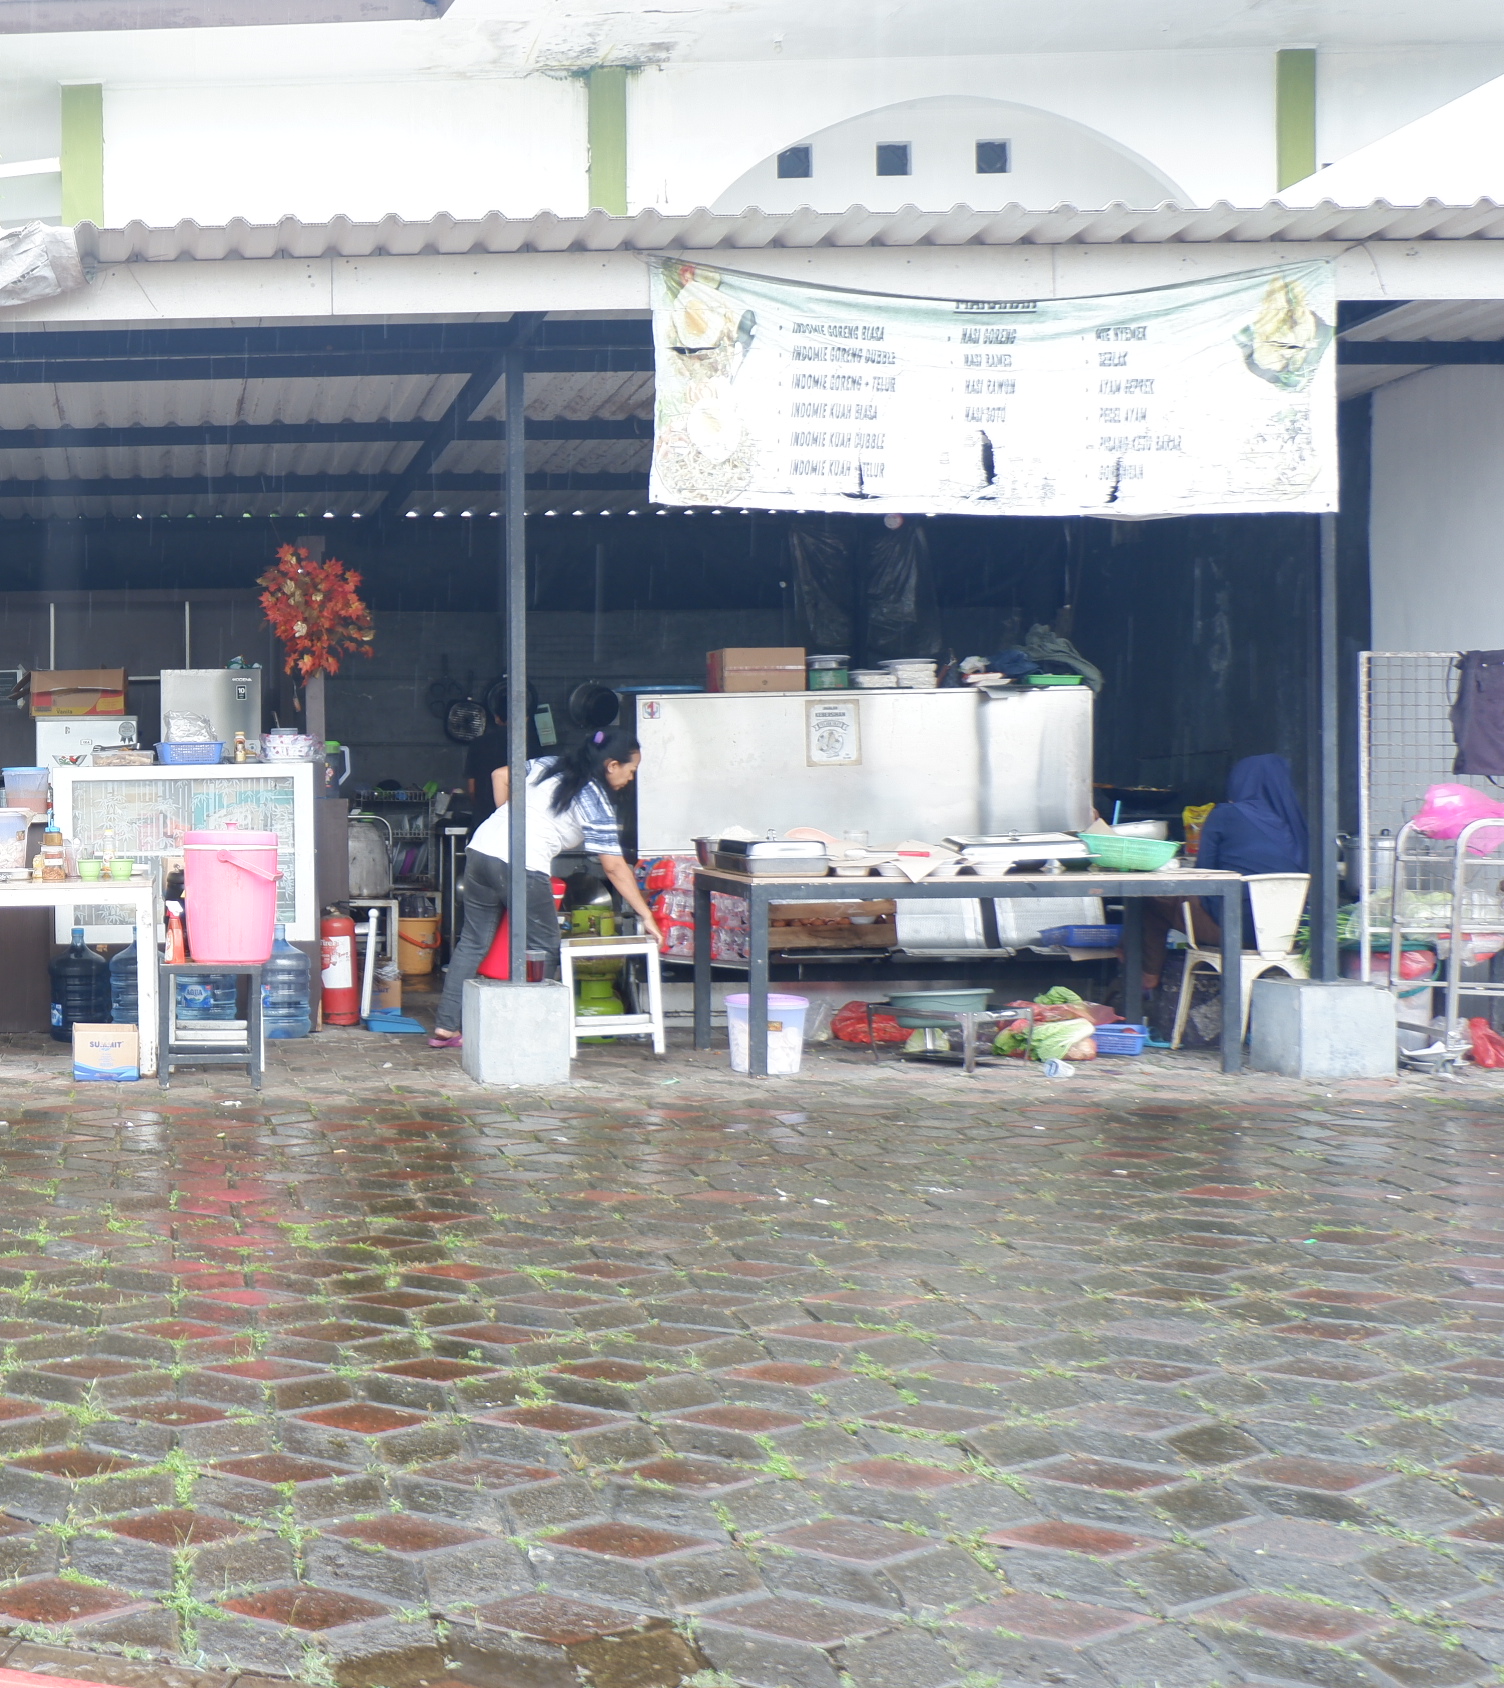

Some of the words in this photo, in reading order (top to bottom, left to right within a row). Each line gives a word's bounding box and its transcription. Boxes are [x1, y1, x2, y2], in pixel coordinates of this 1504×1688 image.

[792, 322, 826, 336] INDOMIE
[827, 325, 859, 340] GORENG
[861, 326, 885, 341] BIASA
[960, 328, 981, 344] NASI
[792, 345, 828, 362] INDOMIE
[830, 346, 863, 363] GORENG
[865, 349, 896, 365] DUBBLE
[792, 373, 828, 390] INDOMIE
[830, 374, 862, 391] GORENG
[872, 376, 896, 392] TELUR
[965, 379, 983, 394] NASI
[791, 402, 827, 418] INDOMIE
[829, 403, 852, 419] KUAH
[854, 404, 878, 420] BIASA
[790, 431, 827, 448] INDOMIE
[828, 432, 852, 449] KUAH
[854, 432, 886, 449] DUBBLE
[790, 459, 827, 476] INDOMIE
[828, 460, 852, 476] KUAH
[862, 462, 885, 478] TELUR
[186, 988, 203, 996] AQUA
